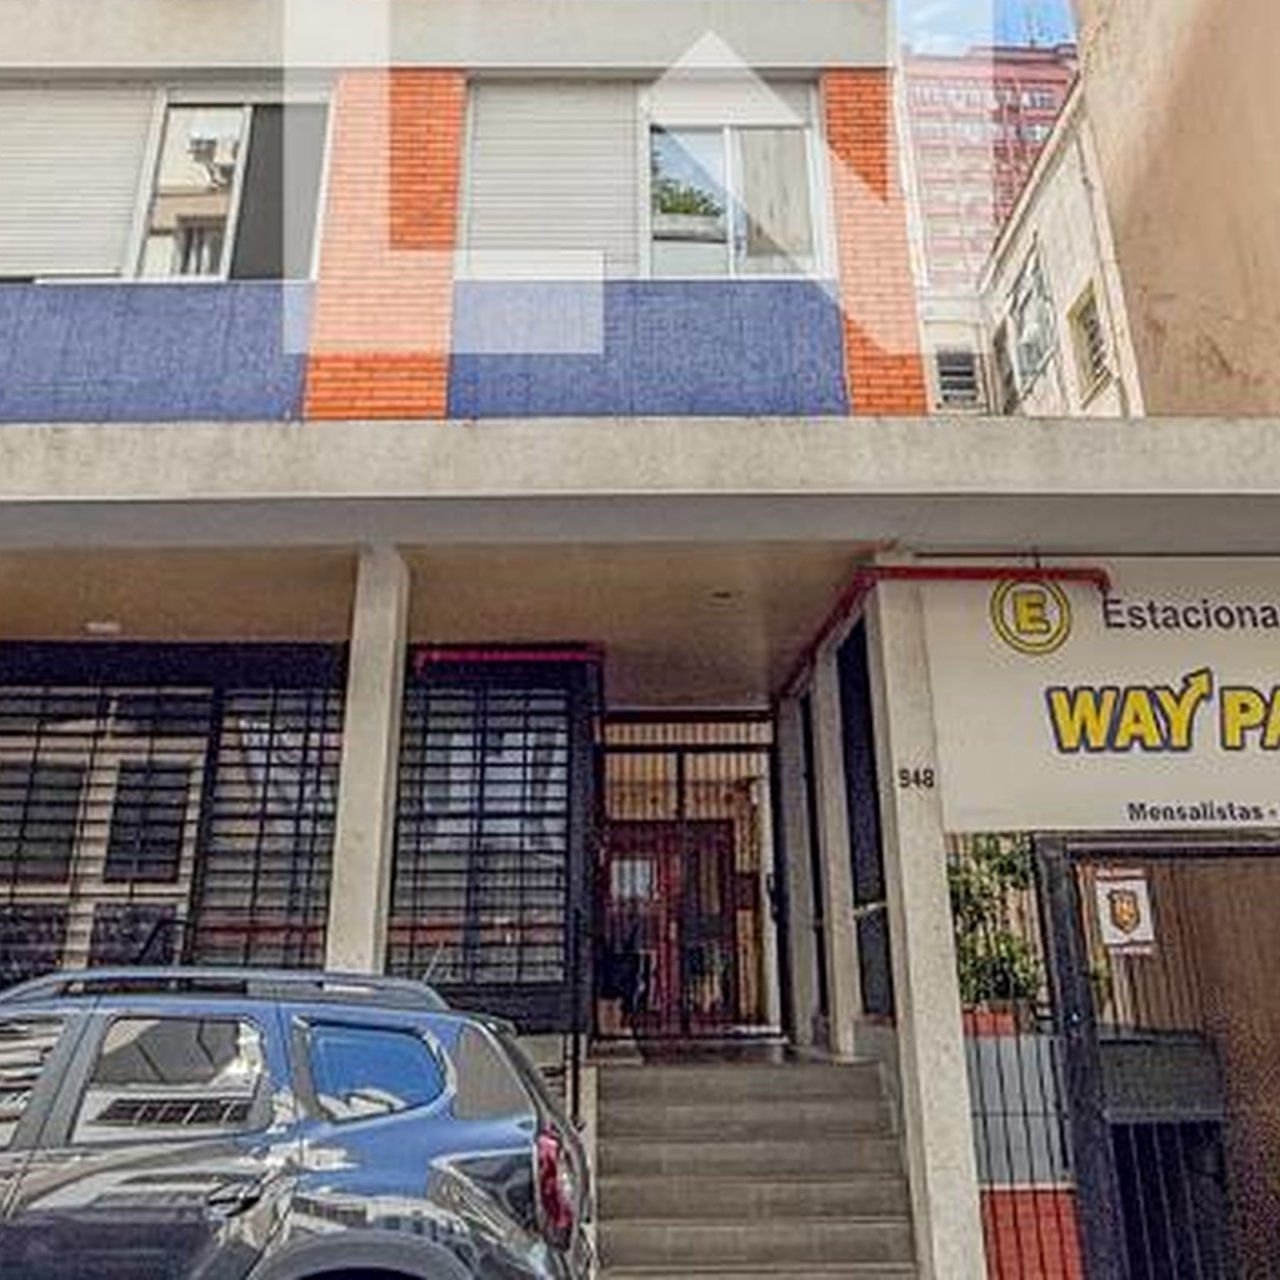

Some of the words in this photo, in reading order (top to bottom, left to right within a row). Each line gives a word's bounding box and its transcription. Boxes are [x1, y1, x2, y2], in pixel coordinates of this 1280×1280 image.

[1014, 588, 1051, 634] E
[1046, 668, 1213, 753] WAY
[1127, 801, 1264, 822] Mensalistas
